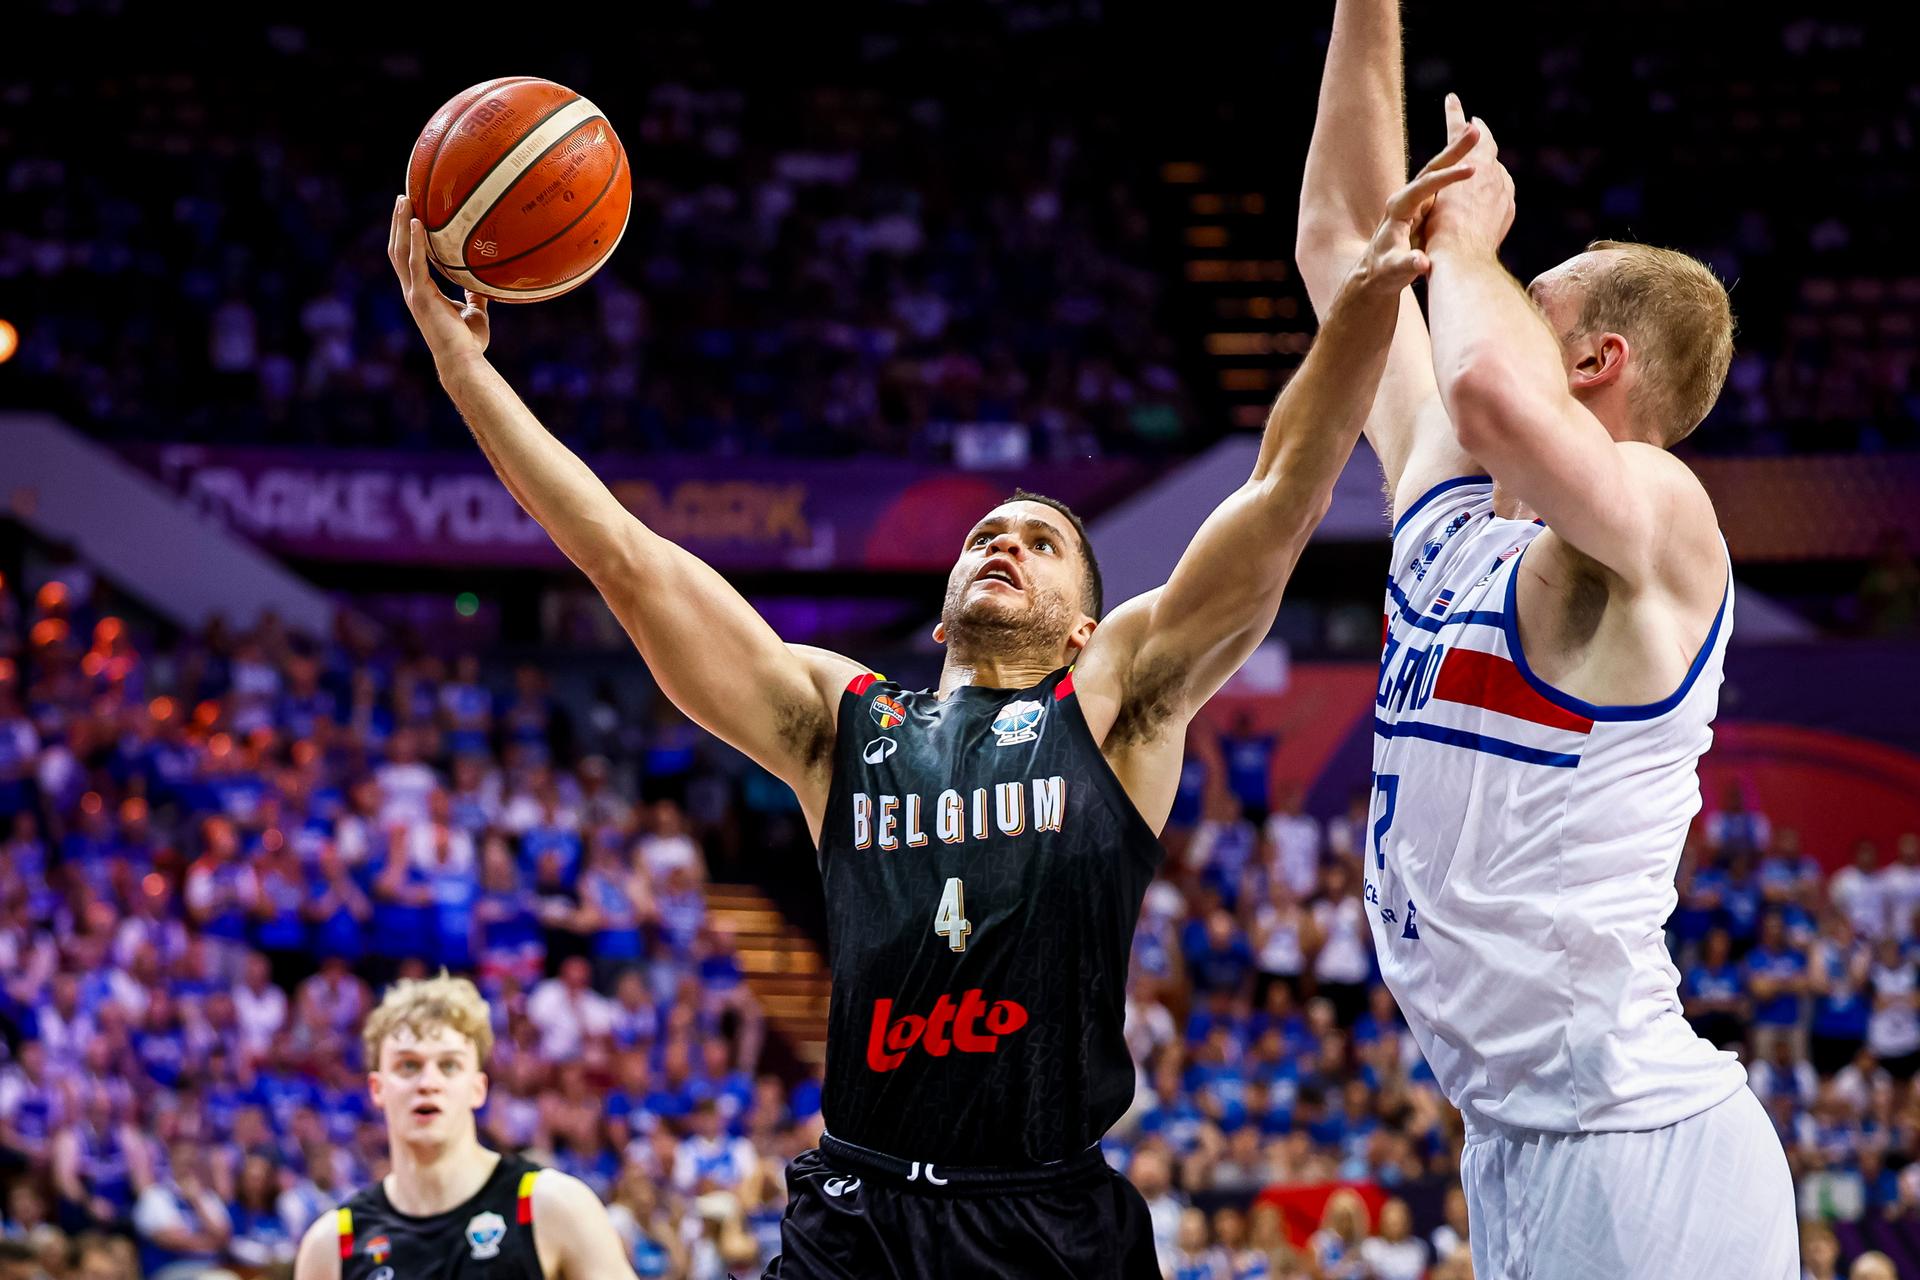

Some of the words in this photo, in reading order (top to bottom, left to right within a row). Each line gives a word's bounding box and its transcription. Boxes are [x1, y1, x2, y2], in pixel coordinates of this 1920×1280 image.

[462, 98, 508, 138] FIBA
[479, 109, 516, 142] APPROVED
[853, 776, 1066, 851] BELGIUM
[1372, 771, 1400, 870] 2
[934, 877, 971, 953] 4
[866, 988, 1029, 1072] lotto
